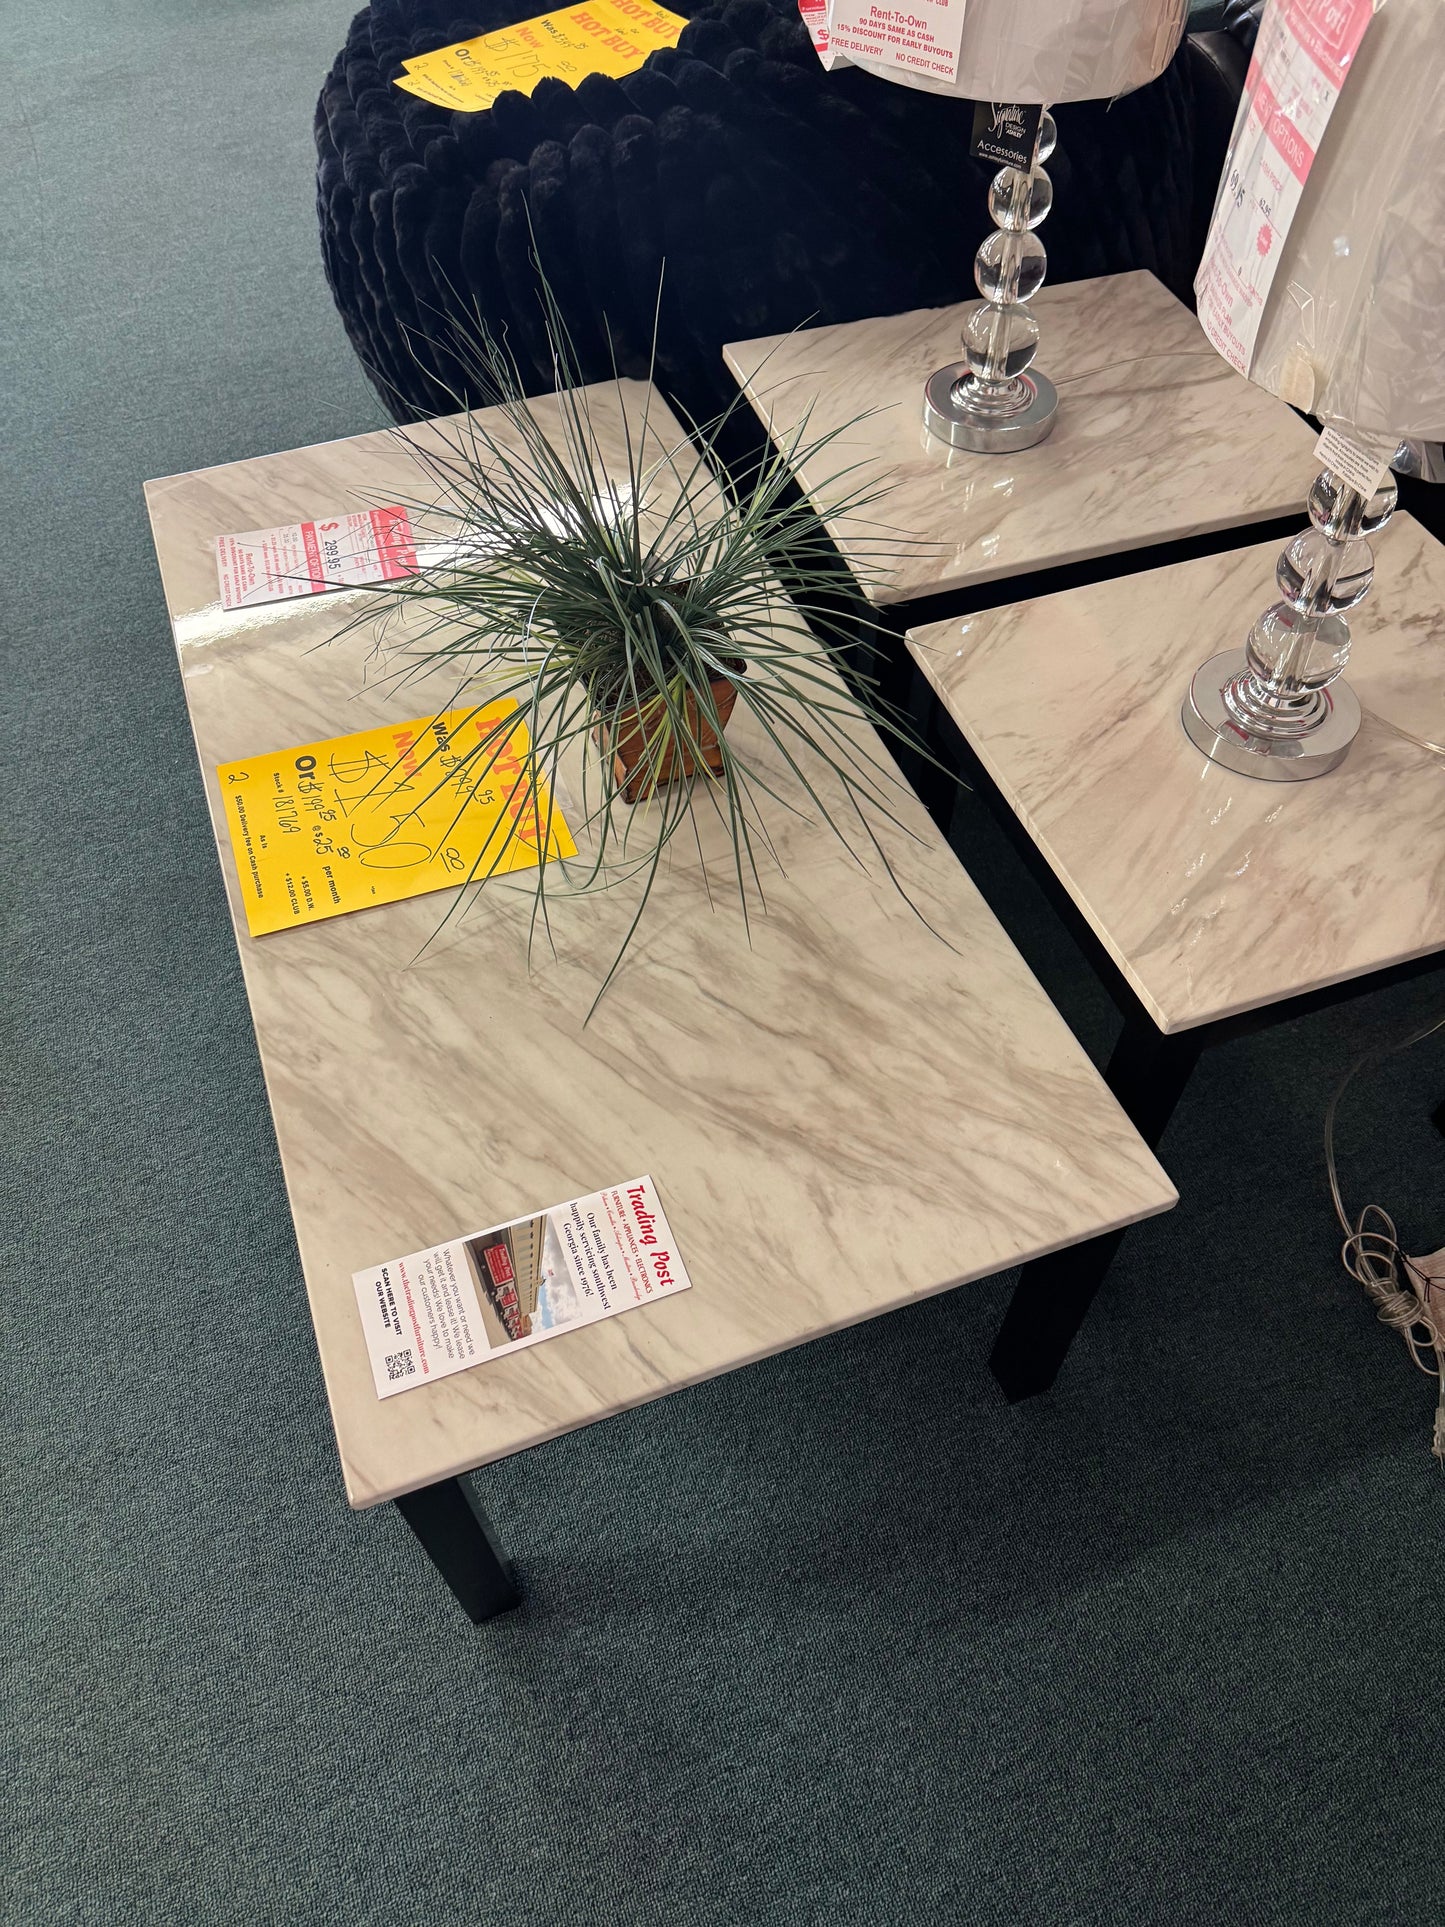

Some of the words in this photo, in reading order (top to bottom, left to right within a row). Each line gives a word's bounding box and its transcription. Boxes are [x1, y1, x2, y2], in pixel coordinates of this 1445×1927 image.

[541, 19, 556, 34] Was
[610, 0, 652, 20] HOT
[642, 16, 680, 39] BUY
[870, 6, 927, 30] Rent-To-Own
[516, 26, 544, 48] Now
[570, 12, 610, 37] HOT
[602, 35, 644, 58] BUY
[817, 28, 830, 41] $
[860, 18, 868, 26] 90
[868, 20, 886, 30] DAYS
[888, 24, 906, 34] SAME
[907, 28, 916, 38] AS
[917, 32, 934, 42] CASH
[831, 37, 850, 48] FREE
[851, 42, 883, 56] DELIVERY
[836, 24, 850, 32] 15%
[852, 26, 886, 40] DISCOUNT
[888, 34, 901, 44] FOR
[902, 38, 922, 50] EARLY
[924, 44, 954, 58] BUYOUTS
[455, 48, 474, 64] Or
[896, 52, 906, 62] NO
[907, 55, 930, 68] CREDIT
[932, 62, 954, 75] CHECK
[977, 140, 1027, 164] Accessories
[1272, 118, 1304, 167] OPTIONS
[1211, 328, 1226, 352] CREDIT
[1226, 349, 1246, 373] CHECK
[319, 522, 339, 532] $
[325, 540, 340, 570] 299.95
[310, 557, 322, 584] OPTION
[432, 722, 450, 752] Was
[392, 730, 422, 778] Now
[228, 771, 249, 784] 2
[273, 772, 282, 788] Stock
[476, 717, 520, 776] HOT
[500, 782, 546, 840] BUY
[235, 795, 245, 813] $50.00
[239, 814, 249, 836] Delivery
[295, 755, 316, 783] Or
[322, 865, 333, 878] per
[329, 882, 341, 904] month
[259, 834, 266, 842] As
[247, 847, 253, 855] on
[249, 855, 257, 870] Cash
[251, 871, 263, 898] purchase
[285, 877, 296, 897] $12.00
[301, 880, 311, 897] $5.00
[306, 897, 314, 910] D.W.
[290, 898, 300, 914] CLUB
[611, 1190, 626, 1217] FURNITURE
[623, 1223, 638, 1253] APPLIANCES
[635, 1258, 653, 1293] ELECTRONICS
[627, 1185, 658, 1245] Trading
[650, 1251, 674, 1286] Post
[433, 1251, 443, 1265] will
[563, 1222, 578, 1254] Georgia
[574, 1254, 584, 1275] since
[580, 1277, 594, 1296] 1976!
[570, 1202, 584, 1230] happily
[580, 1232, 596, 1268] servicing
[592, 1269, 611, 1309] southwest
[586, 1212, 596, 1228] Our
[592, 1229, 606, 1253] family
[600, 1254, 609, 1269] has
[606, 1269, 617, 1290] been
[423, 1258, 433, 1274] your
[434, 1264, 445, 1277] get
[443, 1248, 456, 1281] Whatever
[381, 1267, 391, 1287] SCAN
[417, 1274, 426, 1285] our
[428, 1275, 440, 1299] needs!
[386, 1287, 395, 1306] HERE
[440, 1283, 451, 1297] and
[449, 1282, 459, 1296] you
[375, 1281, 383, 1296] OUR
[379, 1297, 391, 1328] WEBSITE
[390, 1306, 397, 1317] TO
[421, 1287, 435, 1324] customers
[435, 1298, 443, 1312] We
[444, 1297, 454, 1317] lease
[455, 1296, 465, 1315] want
[393, 1317, 402, 1335] VISIT
[399, 1263, 429, 1373] www.thetradingpostfurniture.com
[438, 1312, 447, 1328] love
[450, 1317, 458, 1325] it!
[459, 1315, 467, 1323] or
[430, 1324, 442, 1349] happy!
[442, 1328, 449, 1337] to
[452, 1324, 460, 1338] We
[462, 1323, 473, 1343] need
[444, 1338, 454, 1358] make
[455, 1338, 465, 1359] lease
[467, 1343, 475, 1355] we
